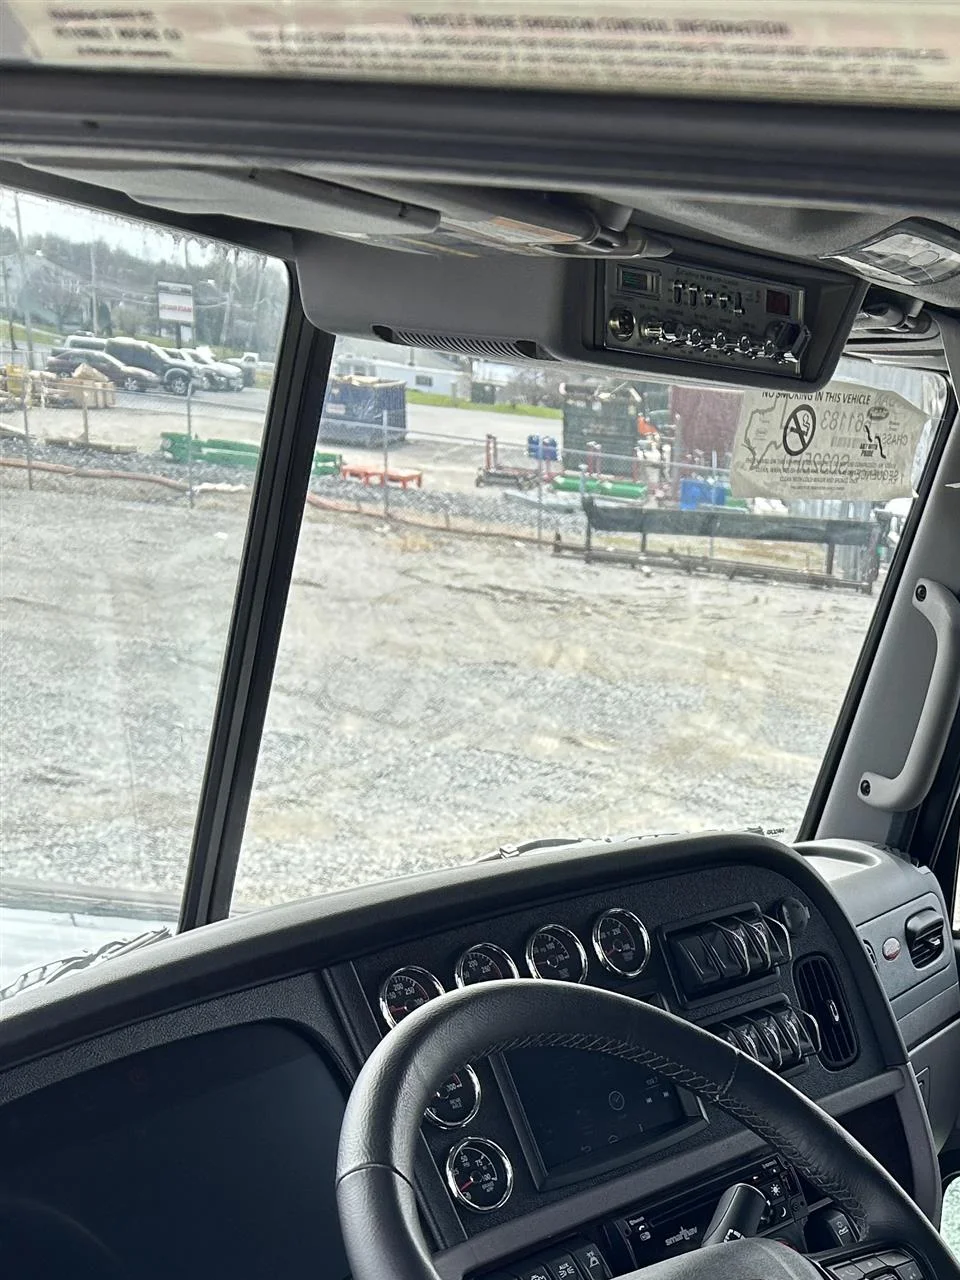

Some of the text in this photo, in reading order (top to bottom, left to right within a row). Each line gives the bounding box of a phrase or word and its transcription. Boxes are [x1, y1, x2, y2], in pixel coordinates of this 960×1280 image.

[815, 391, 824, 401] IN
[825, 391, 841, 403] THIS
[843, 393, 872, 405] VEHICLE
